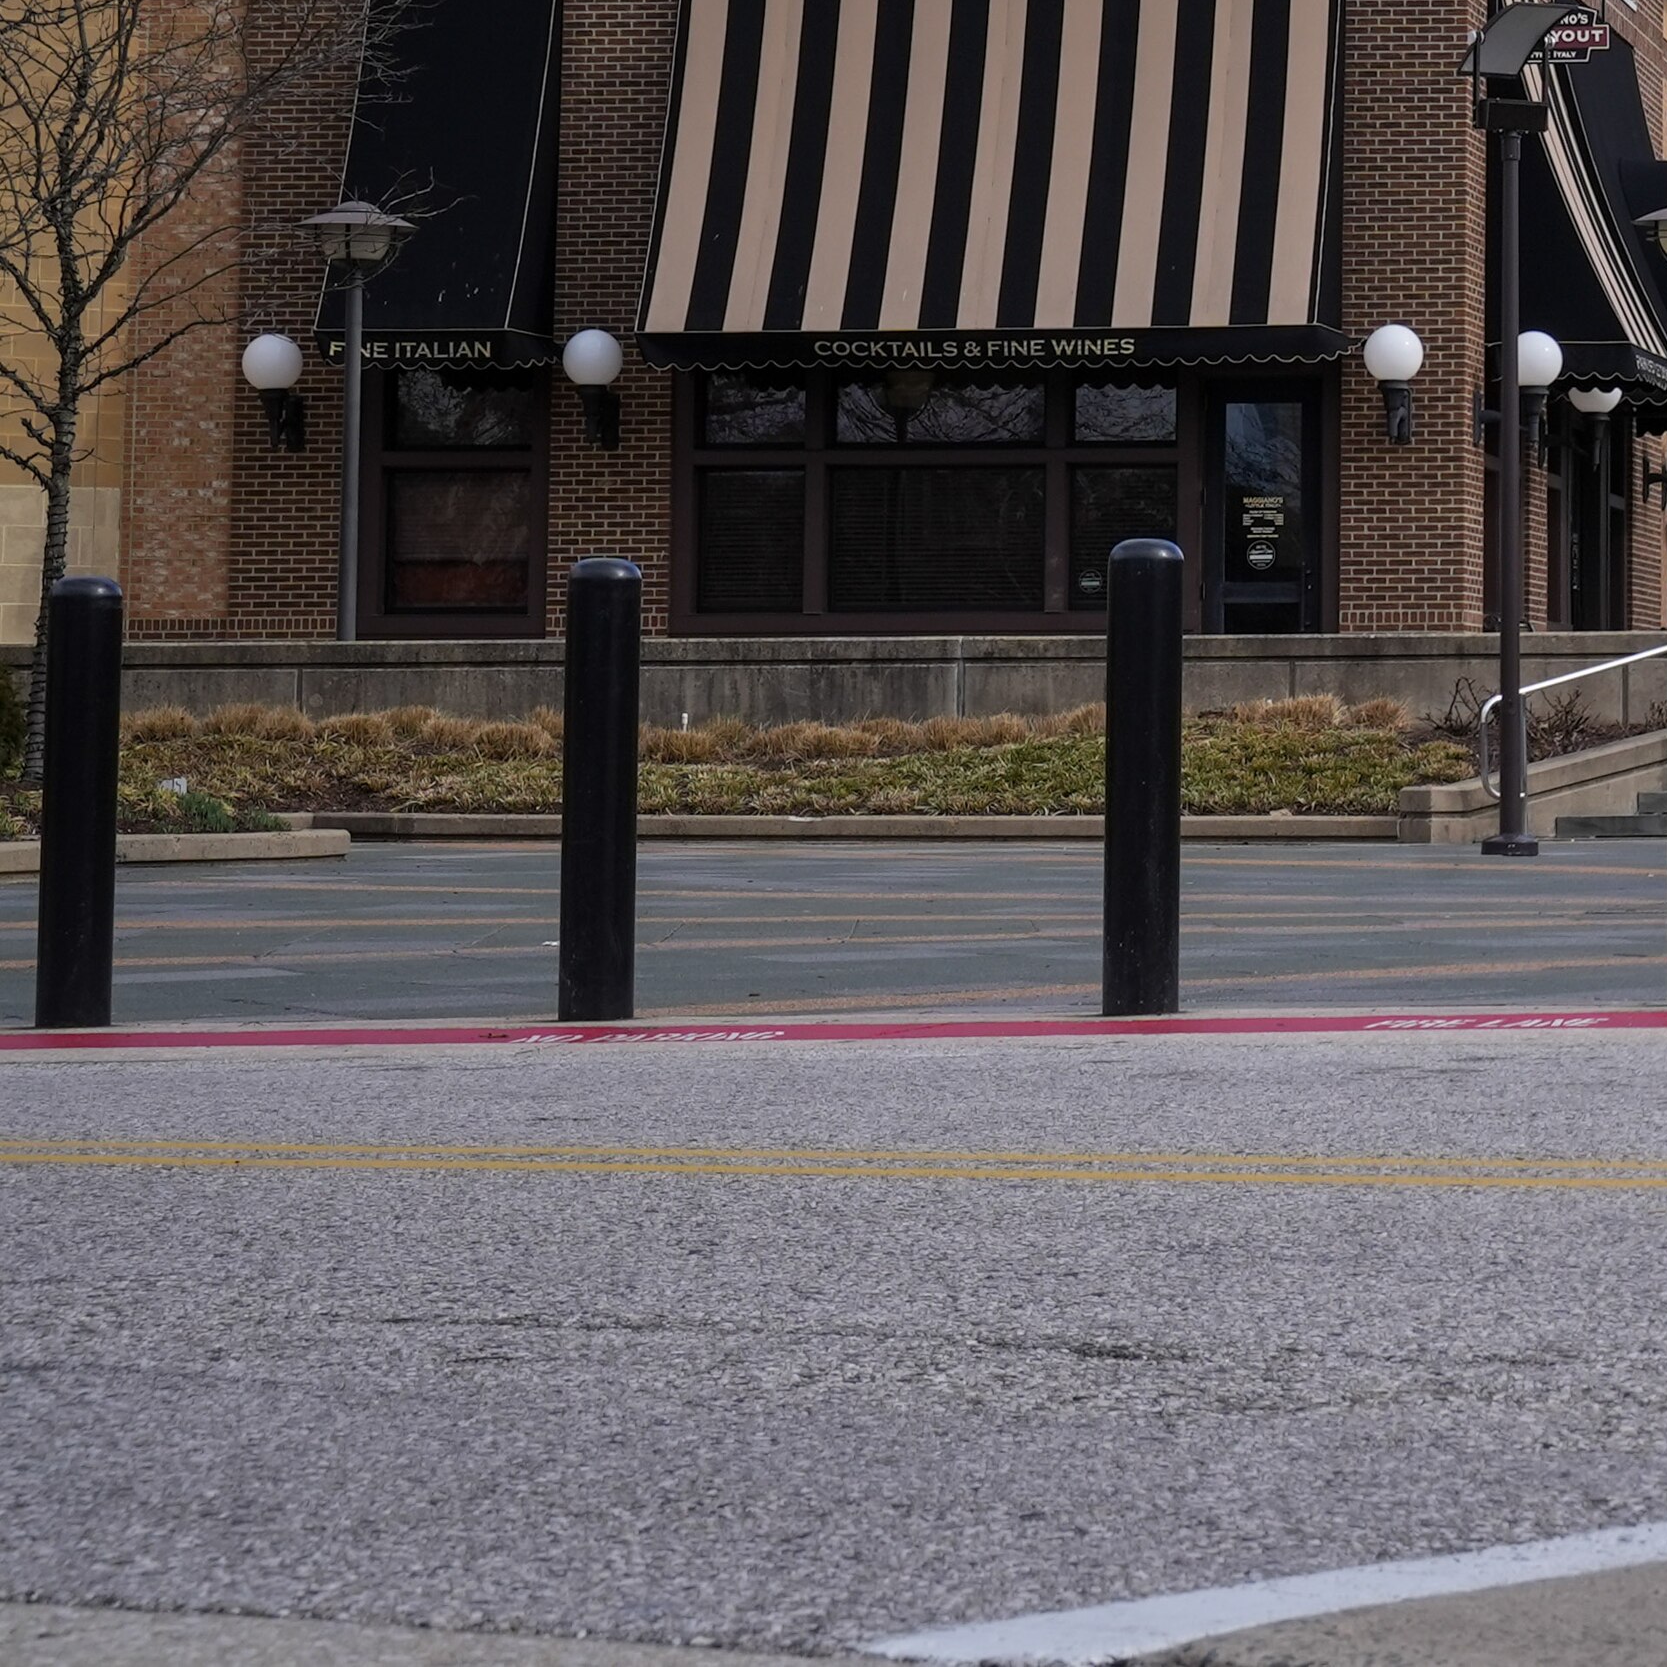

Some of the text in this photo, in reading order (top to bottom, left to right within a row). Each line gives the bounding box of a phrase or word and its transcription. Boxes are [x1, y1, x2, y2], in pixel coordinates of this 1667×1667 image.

[1550, 29, 1604, 43] YOUT
[1553, 50, 1577, 58] ITALY
[329, 341, 491, 359] FNE ITALIAN
[814, 338, 1136, 357] COCKTAILS & FINE WINES
